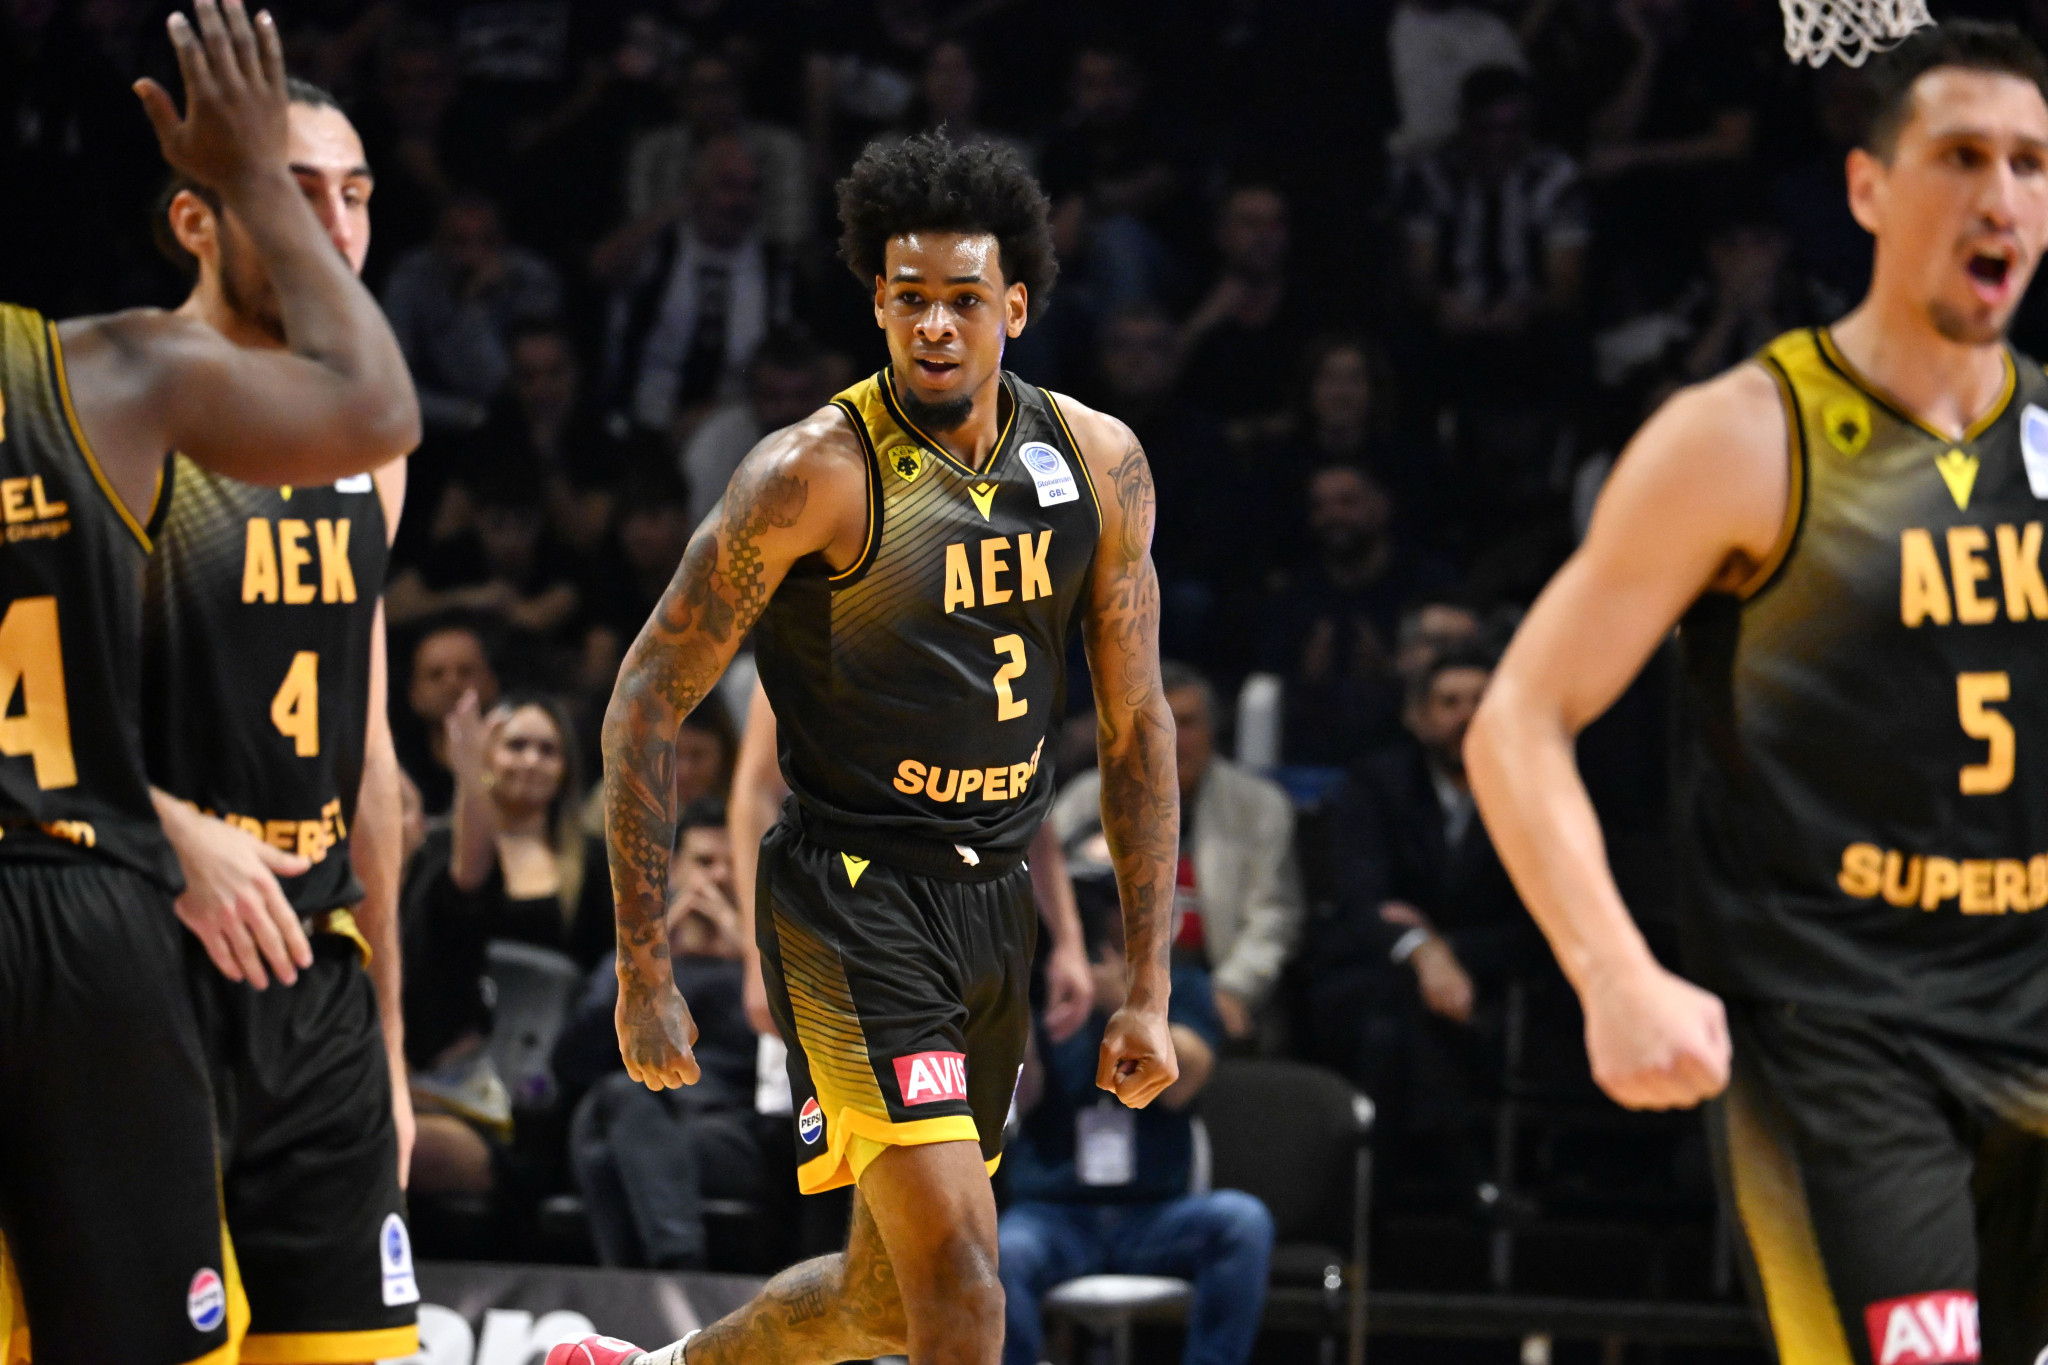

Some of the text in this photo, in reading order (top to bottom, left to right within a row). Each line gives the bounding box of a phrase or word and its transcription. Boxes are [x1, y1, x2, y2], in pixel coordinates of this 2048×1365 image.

[0, 474, 68, 523] EL
[1049, 488, 1068, 498] GBL
[241, 517, 357, 604] AEK
[944, 530, 1053, 614] AEK
[1901, 521, 2048, 627] AEK
[0, 595, 78, 791] 4
[270, 650, 320, 758] 4
[993, 633, 1028, 722] 2
[893, 735, 1045, 804] SUPER
[1956, 670, 2016, 796] 5
[801, 1113, 821, 1128] PEPSI
[1878, 1297, 1980, 1365] AVI
